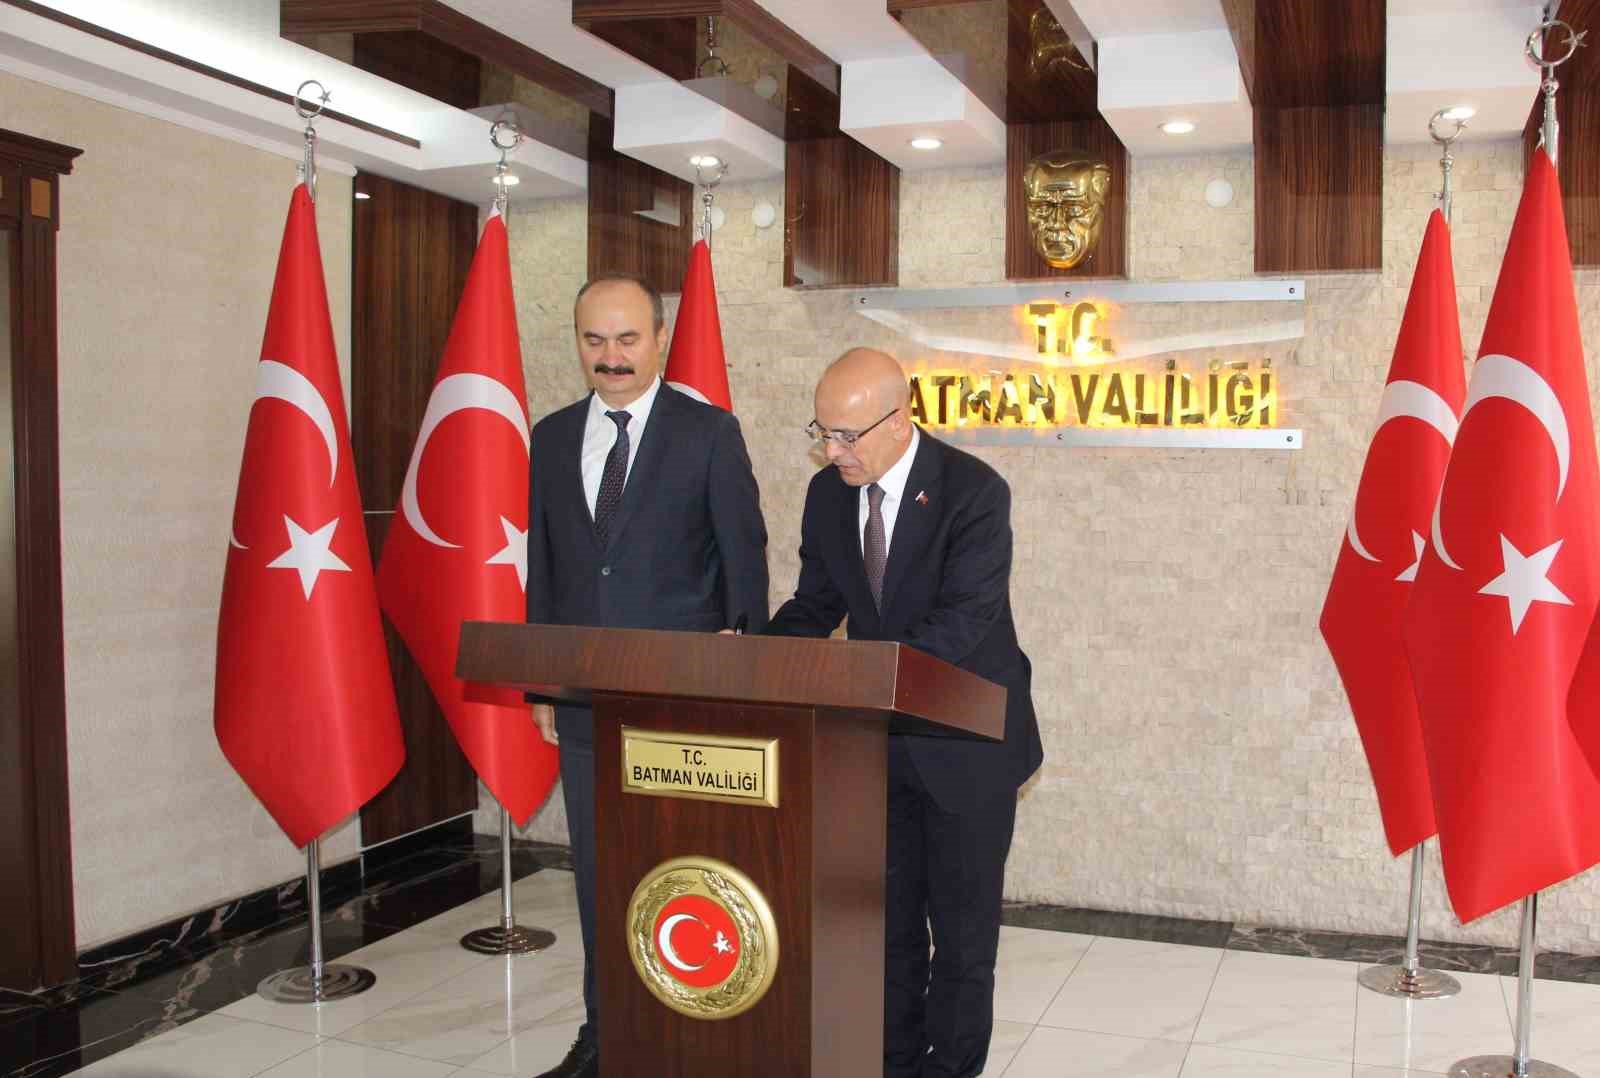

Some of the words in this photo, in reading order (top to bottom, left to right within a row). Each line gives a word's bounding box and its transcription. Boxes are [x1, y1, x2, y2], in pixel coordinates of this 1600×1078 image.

[1029, 302, 1113, 353] T.C.
[909, 374, 1056, 425] ATMAN
[1071, 358, 1271, 425] VALİLİĞİ
[682, 749, 707, 766] T.C.
[633, 766, 692, 785] BATMAN
[697, 769, 757, 791] VALİLİĞİ
